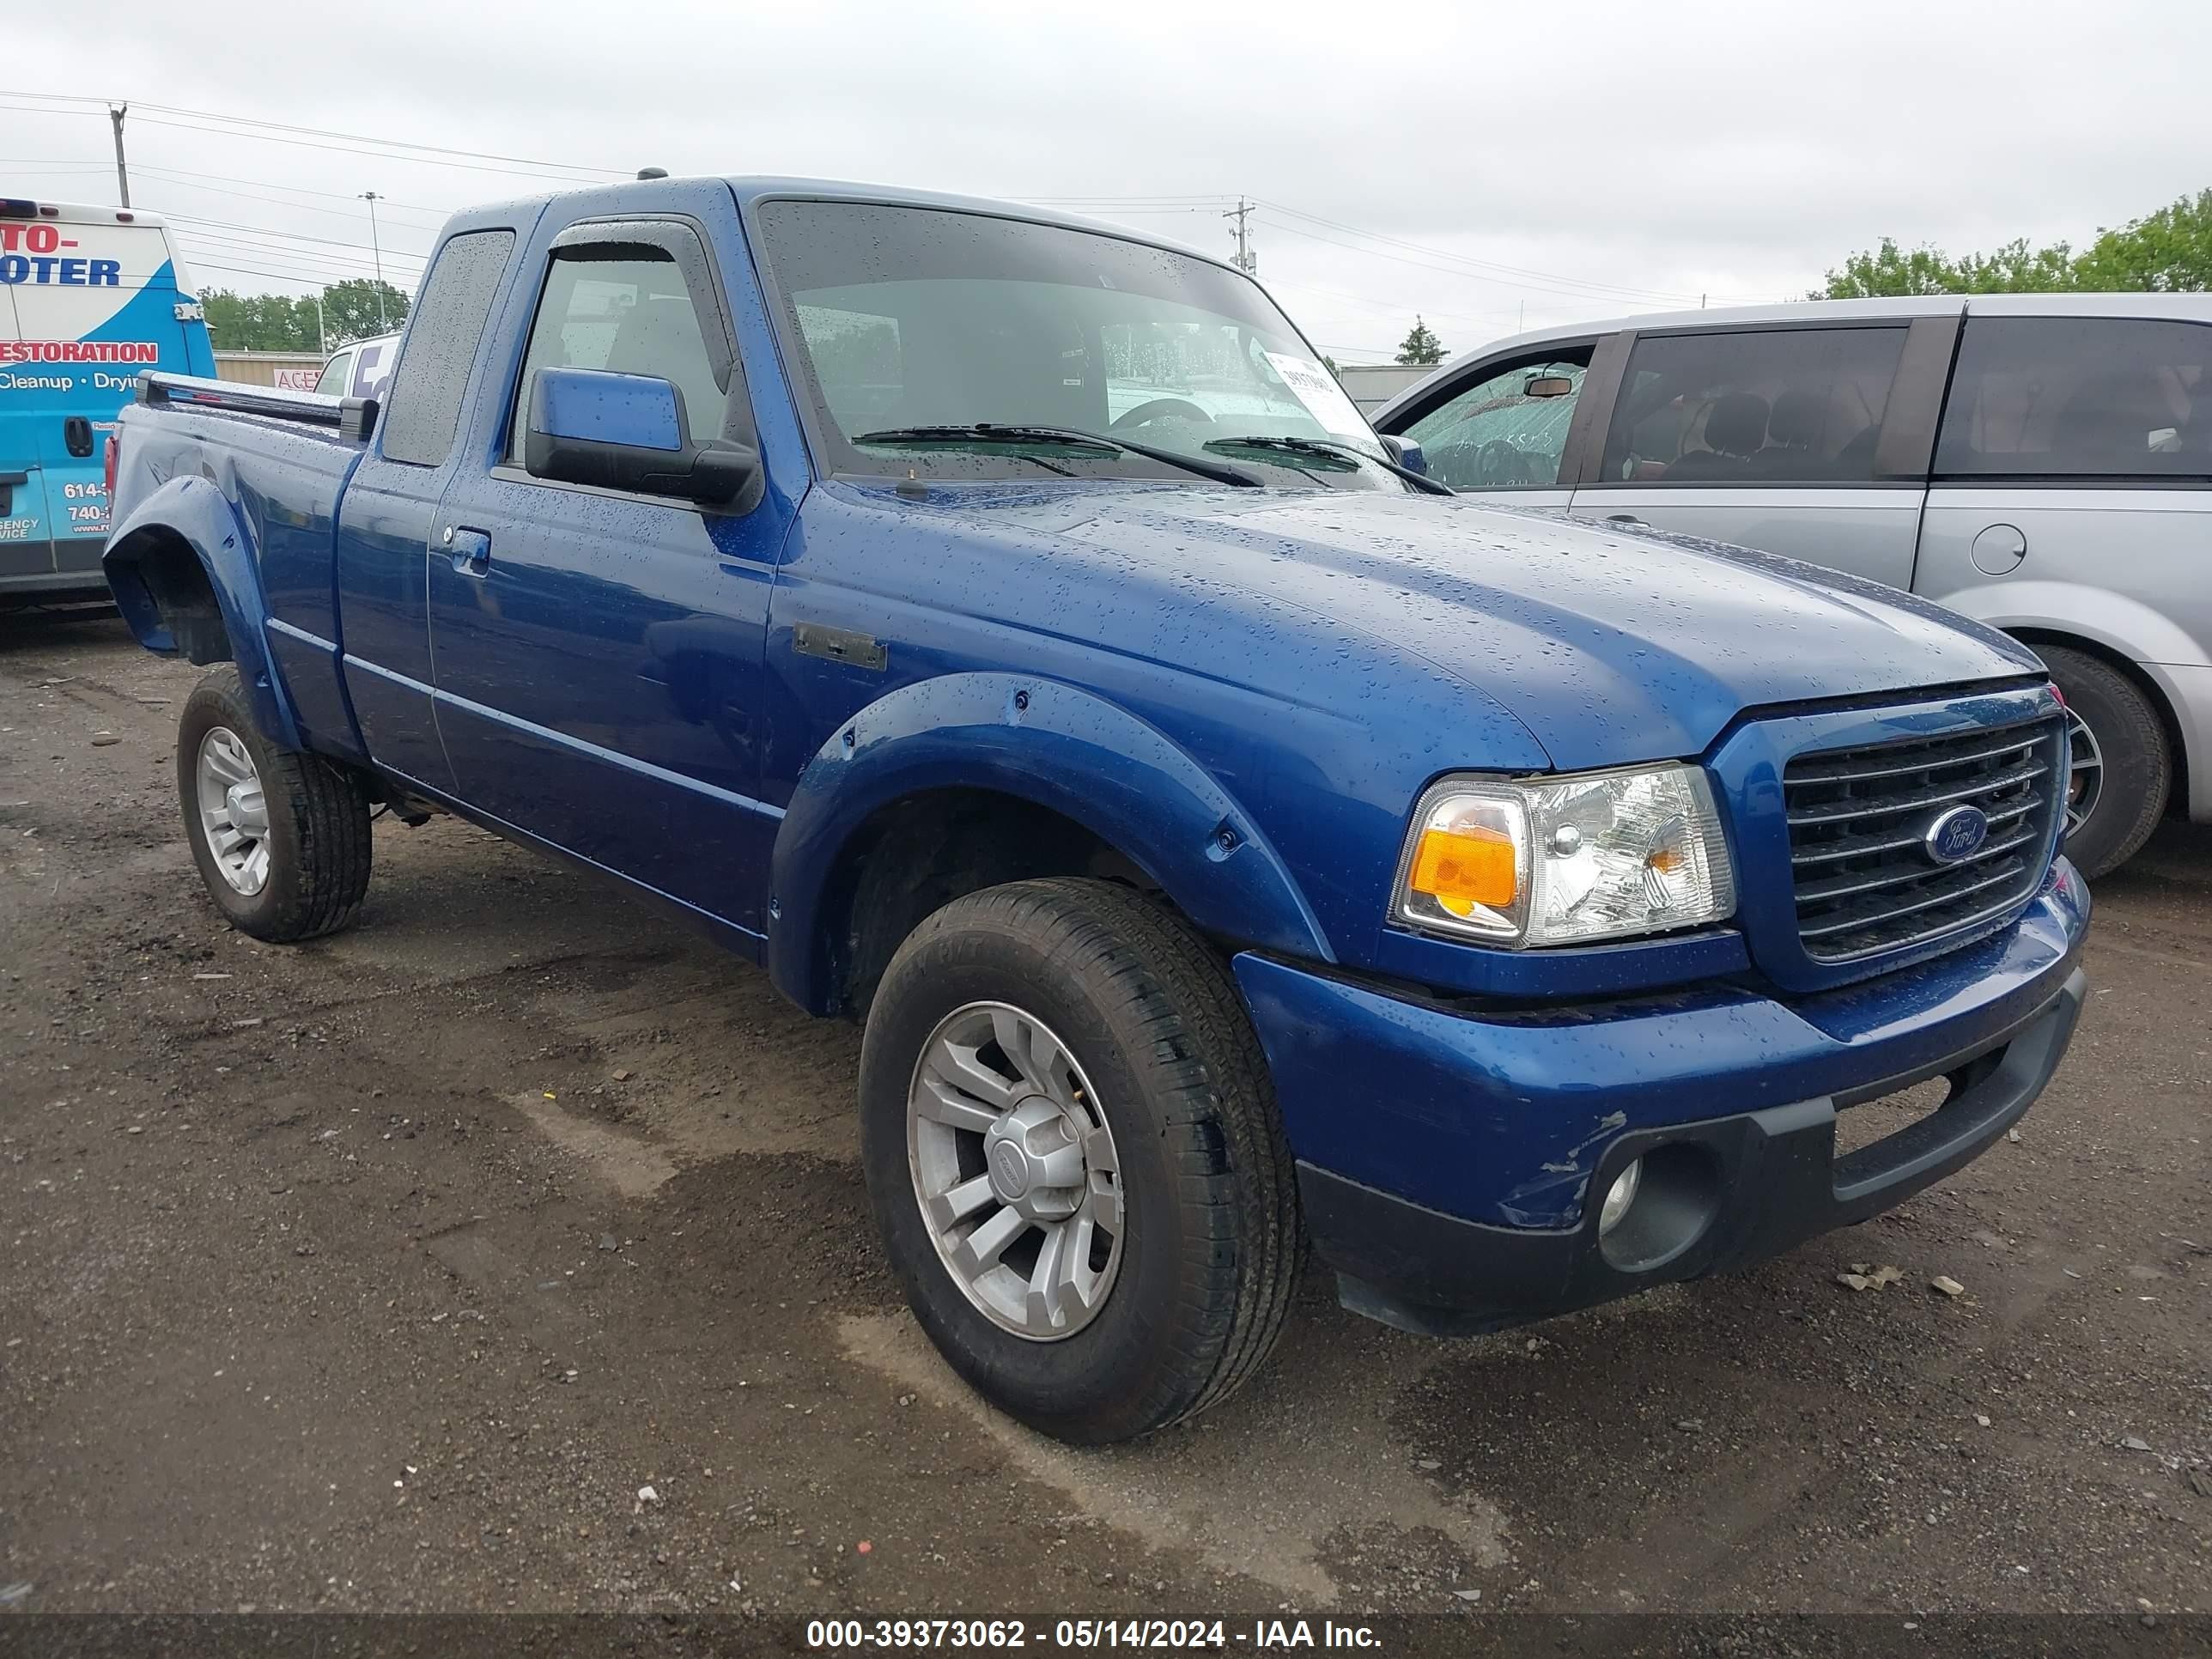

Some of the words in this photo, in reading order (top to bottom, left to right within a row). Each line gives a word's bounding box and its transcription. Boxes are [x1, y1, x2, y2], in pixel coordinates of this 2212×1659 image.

[0, 255, 120, 285] OTER
[0, 373, 73, 392] Cleanup
[1945, 817, 1978, 850] Ford
